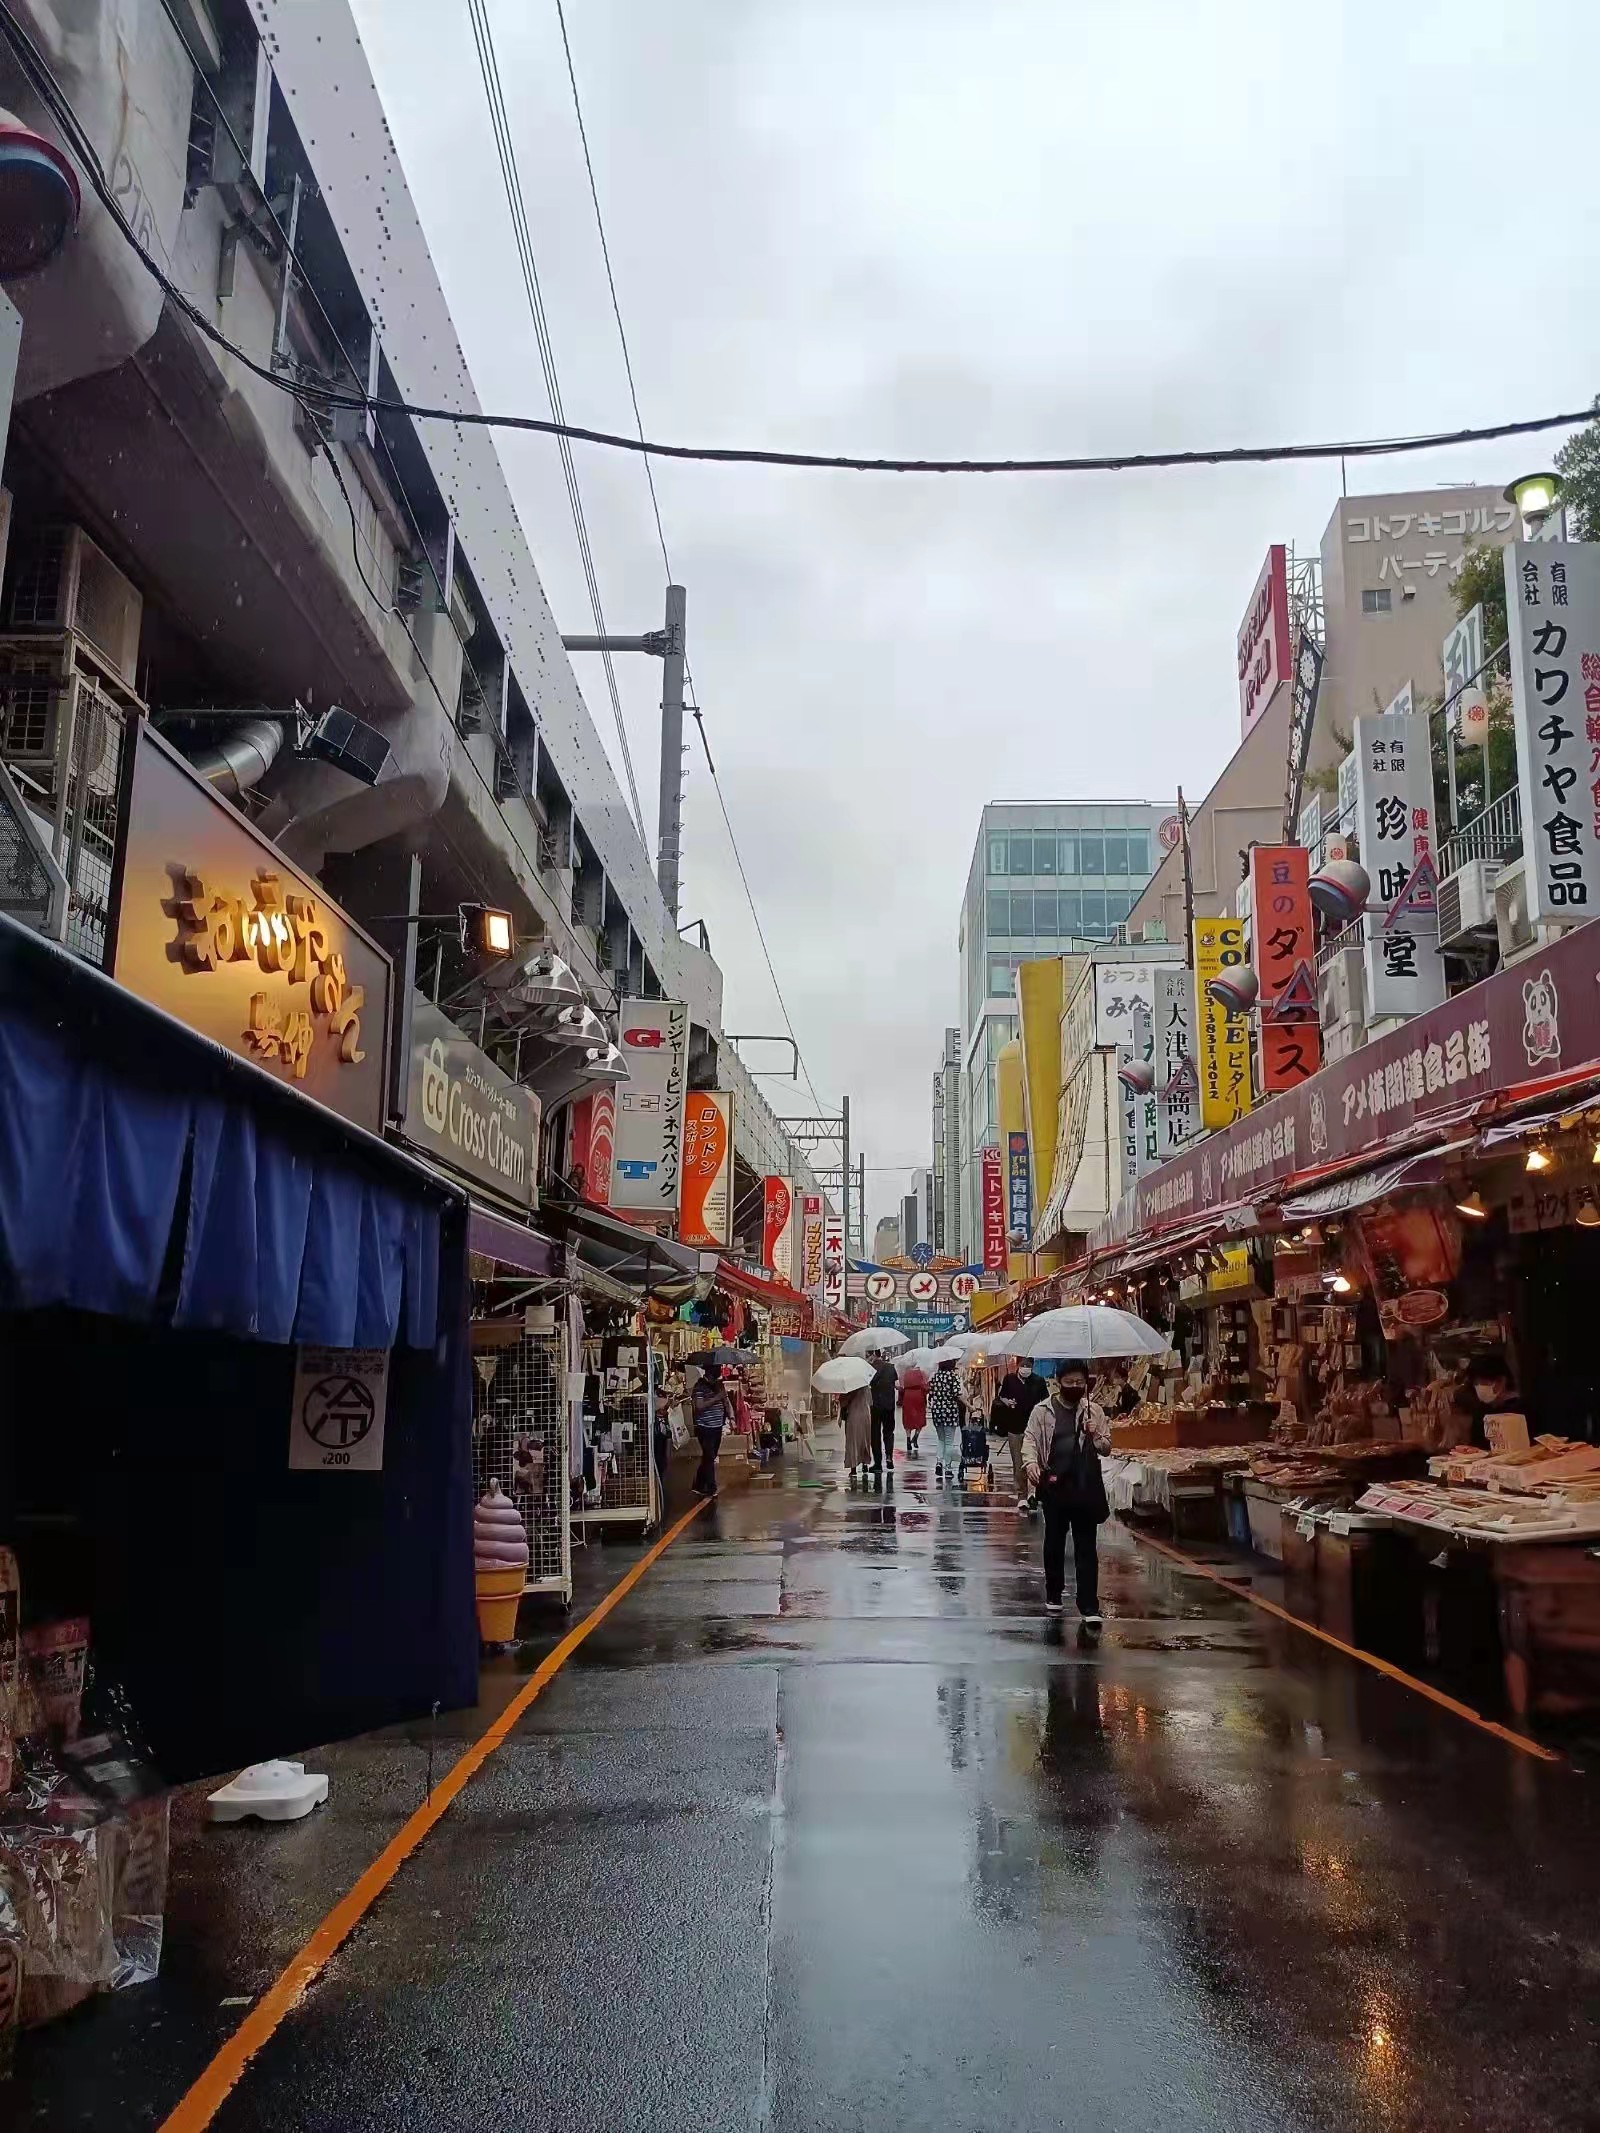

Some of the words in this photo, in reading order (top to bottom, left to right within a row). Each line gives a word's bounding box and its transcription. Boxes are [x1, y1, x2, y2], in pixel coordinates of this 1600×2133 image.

[1348, 506, 1517, 543] コトブキゴルフ
[1532, 619, 1587, 906] カワチヤ食品
[1375, 795, 1418, 978] 珍味堂
[660, 1009, 685, 1198] レジャー&ビジネスパック
[1342, 1019, 1491, 1126] アメ横開運食品街
[450, 1080, 486, 1161] Cross
[488, 1111, 525, 1185] Charm
[685, 1119, 698, 1166] スポーツ
[699, 1107, 717, 1176] ロンドン
[311, 1379, 373, 1444] 冷
[321, 1452, 351, 1466] ¥200
